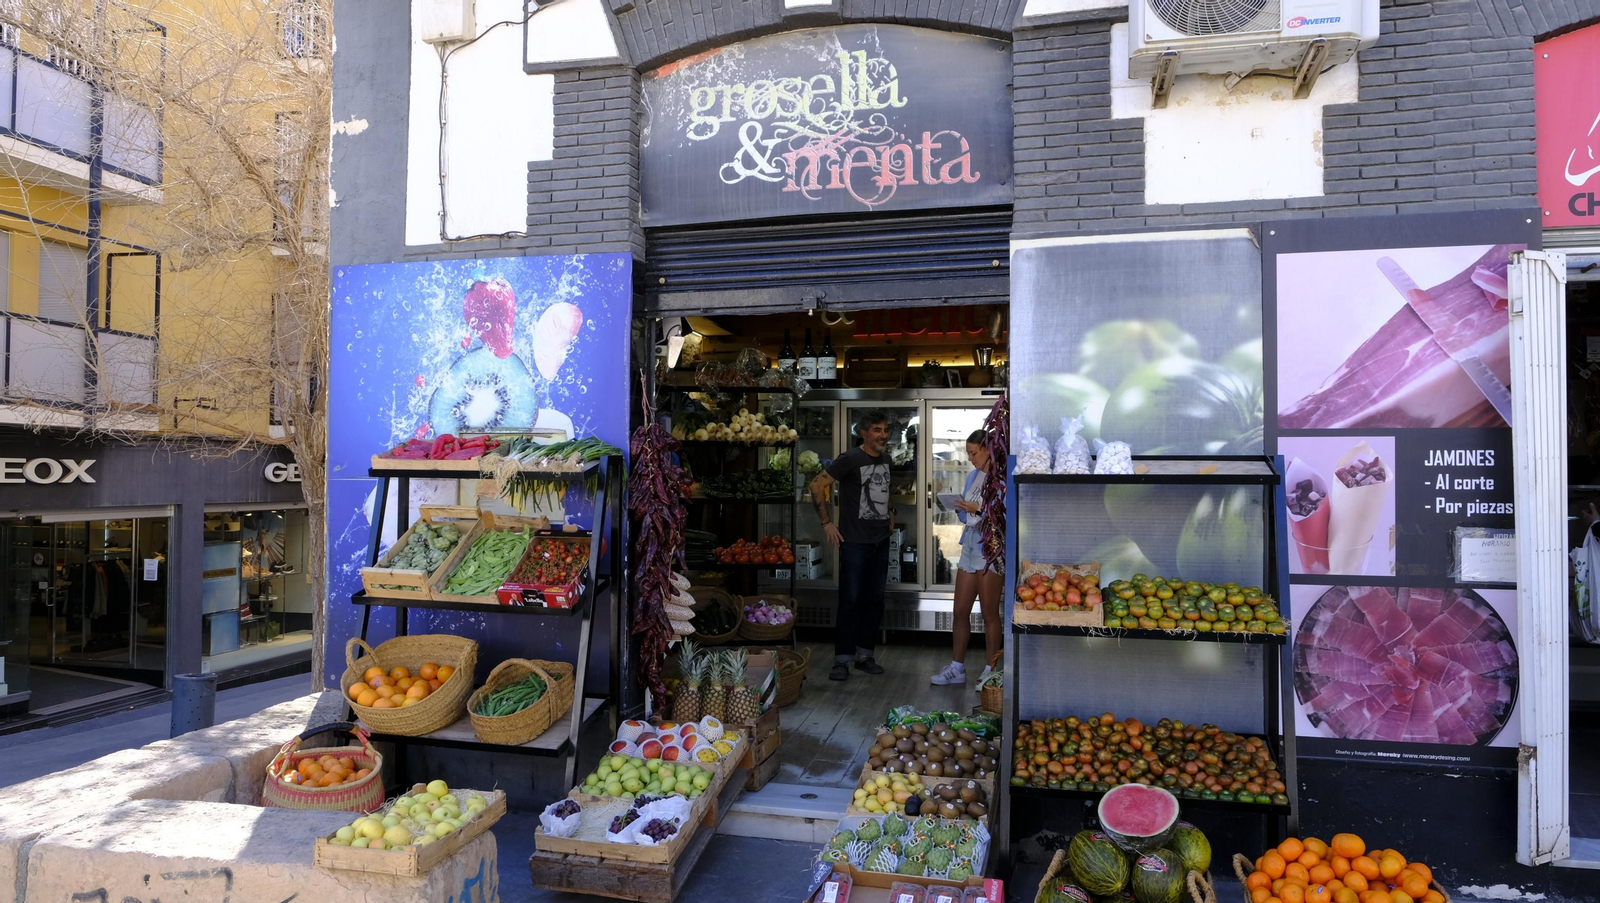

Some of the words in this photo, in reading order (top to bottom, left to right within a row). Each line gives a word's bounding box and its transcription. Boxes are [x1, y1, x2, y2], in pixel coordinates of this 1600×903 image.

[1301, 16, 1341, 25] INVERTER
[686, 50, 908, 141] grosella
[719, 121, 788, 184] &
[782, 130, 980, 205] menta
[1424, 450, 1495, 467] JAMONES
[1435, 473, 1450, 490] Al
[1454, 476, 1495, 490] corte
[1435, 497, 1463, 514] Por
[1466, 499, 1514, 518] piezas
